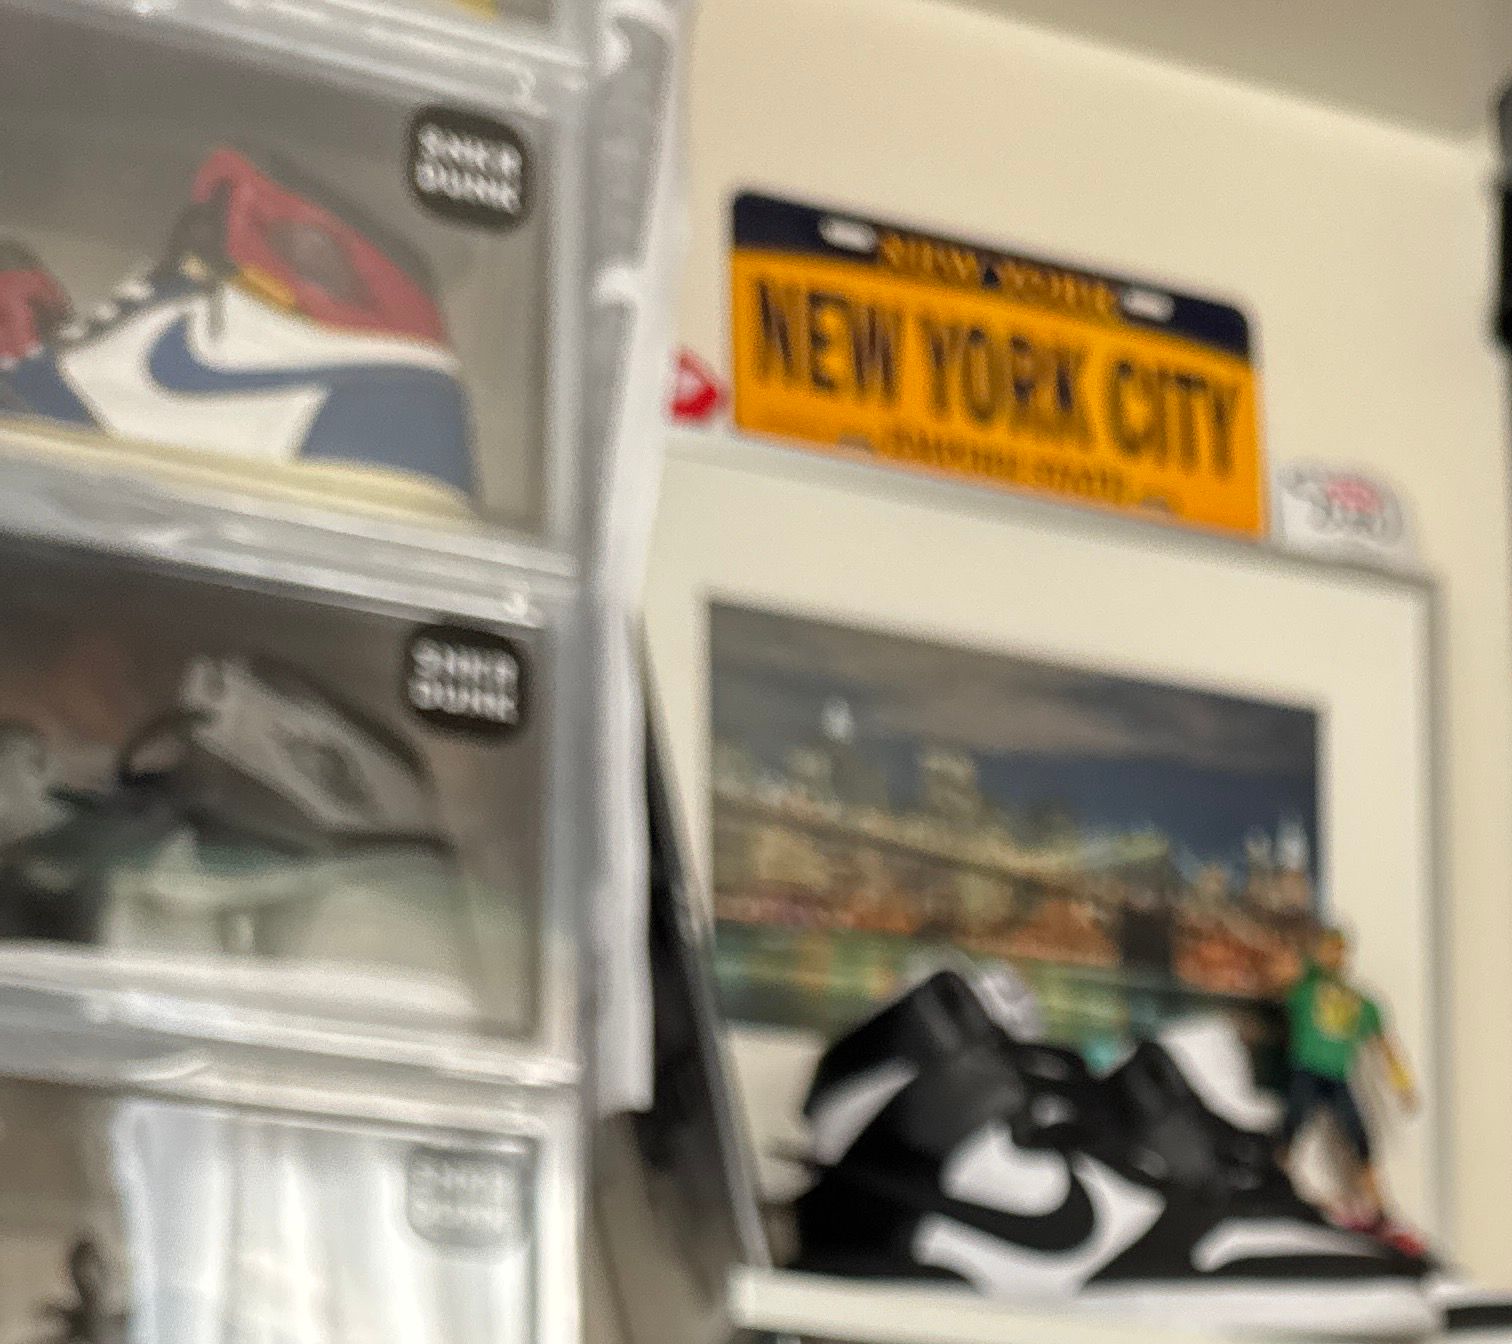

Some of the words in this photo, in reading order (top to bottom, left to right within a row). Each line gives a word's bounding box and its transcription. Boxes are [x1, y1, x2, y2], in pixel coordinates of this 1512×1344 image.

[753, 275, 903, 408] NEW
[920, 316, 1096, 450] YORK
[1107, 356, 1239, 480] CITY
